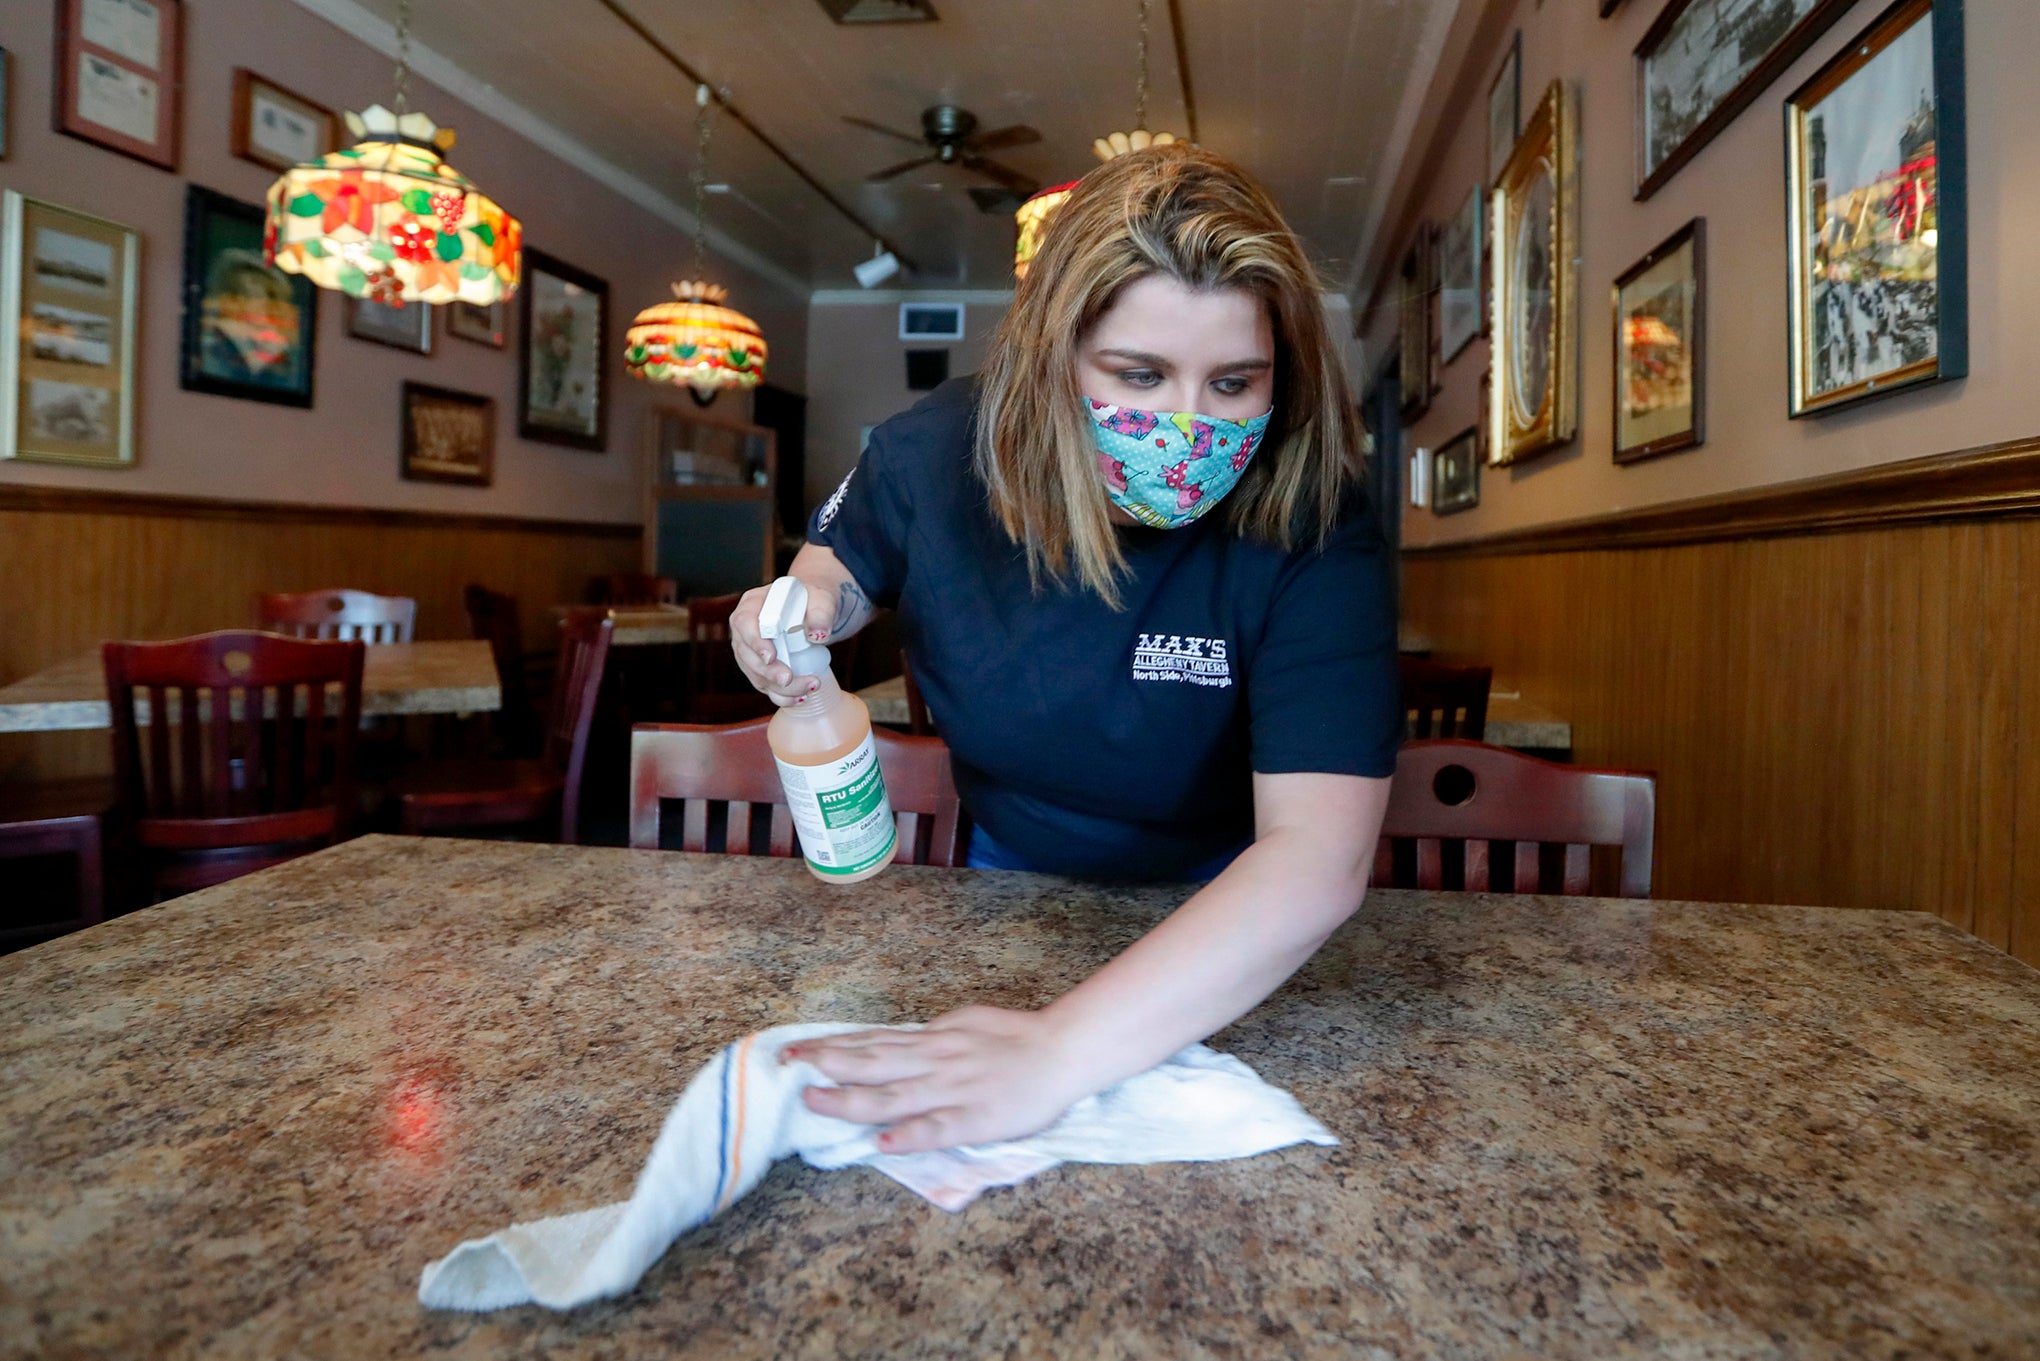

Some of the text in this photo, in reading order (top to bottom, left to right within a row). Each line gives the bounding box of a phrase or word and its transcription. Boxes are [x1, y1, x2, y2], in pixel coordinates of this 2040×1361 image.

[1135, 634, 1226, 659] MAX'S
[1134, 655, 1229, 673] ALLEGHENY TAVERN
[1133, 670, 1159, 681] North
[821, 790, 847, 804] RTU
